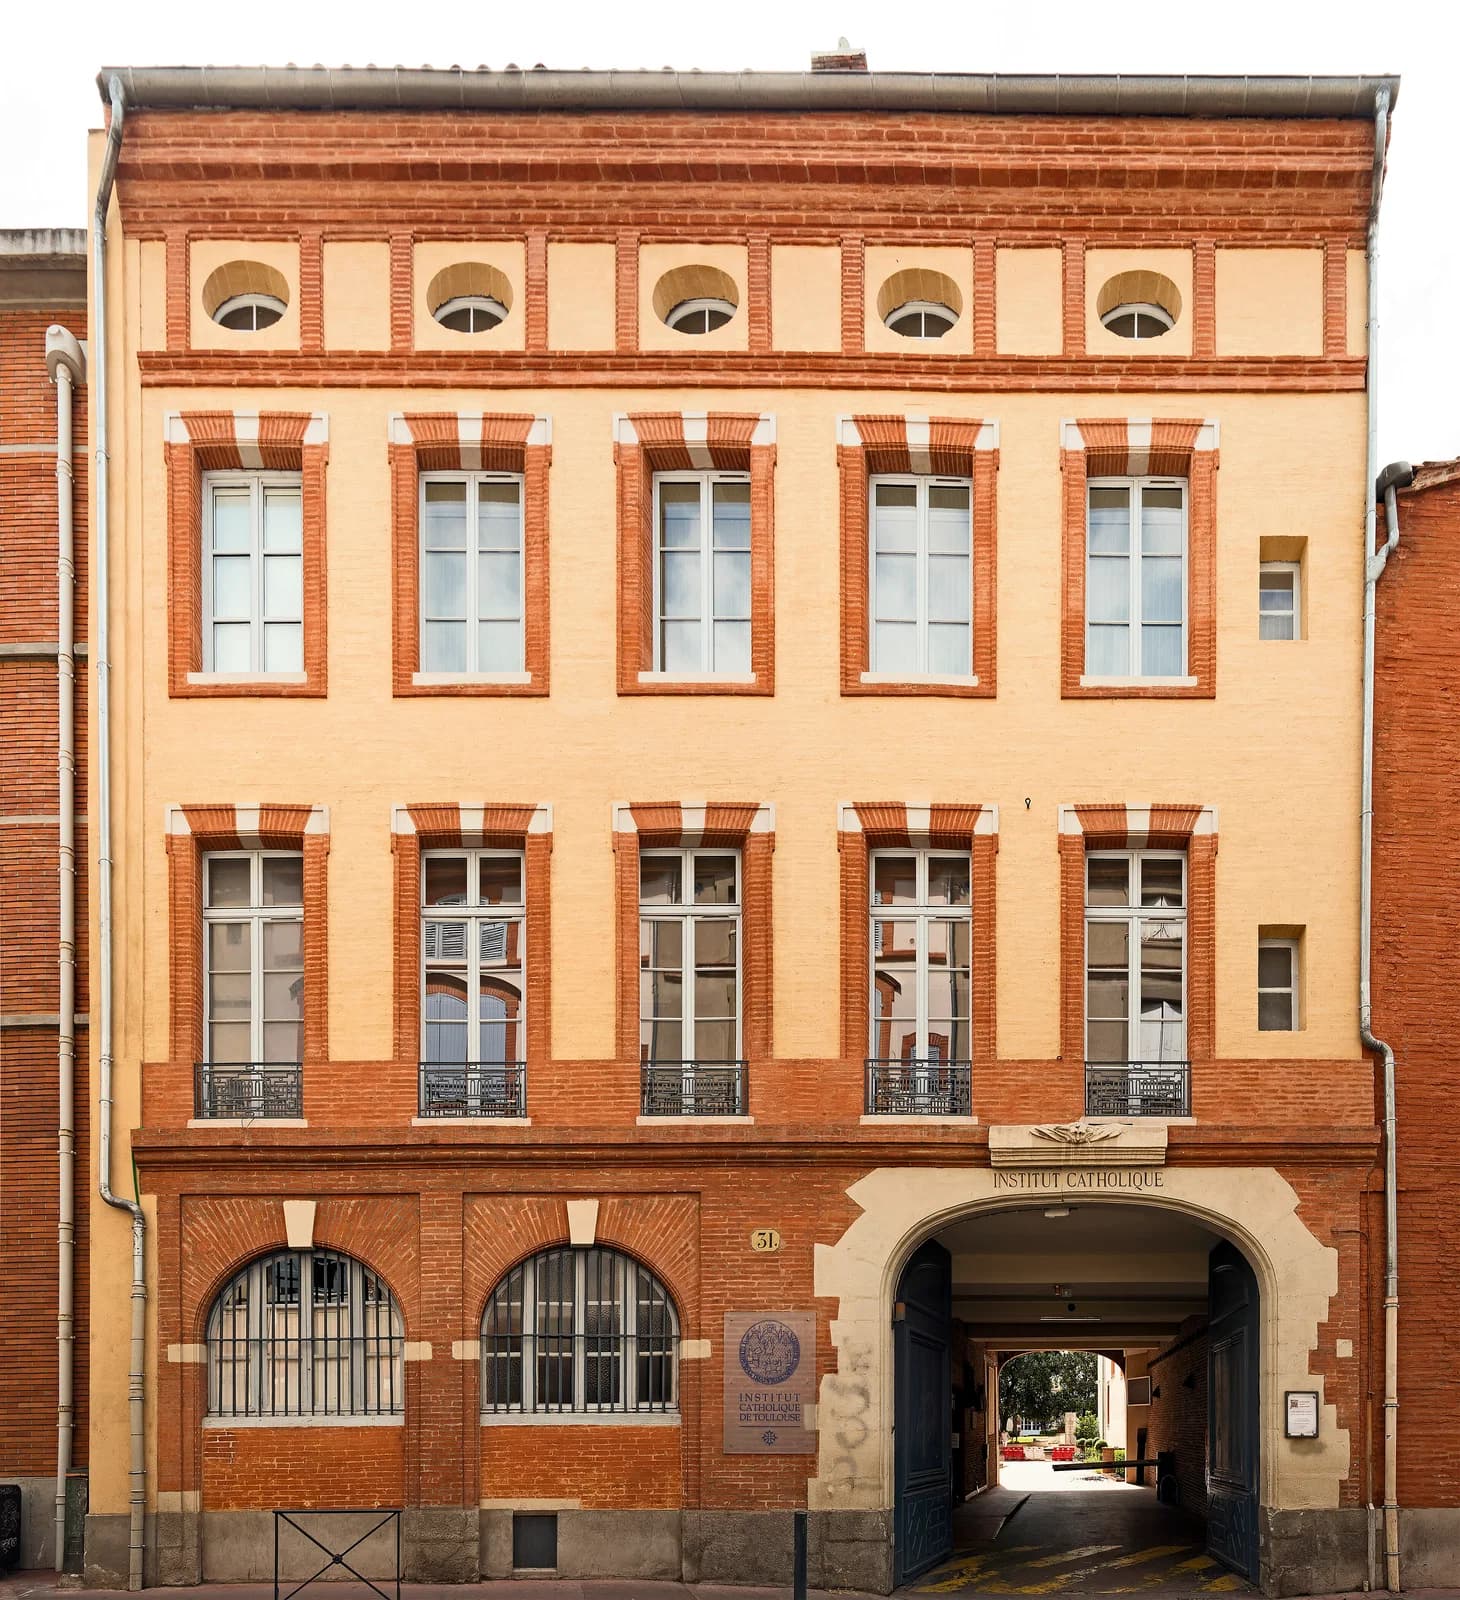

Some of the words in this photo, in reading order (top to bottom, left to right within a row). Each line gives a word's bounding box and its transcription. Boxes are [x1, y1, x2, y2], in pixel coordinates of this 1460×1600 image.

[994, 1172, 1061, 1188] INSTITUT
[1066, 1172, 1164, 1191] CATHOLIQUE
[739, 1393, 801, 1402] INSTITUT
[739, 1403, 801, 1413] CATHOLIQUE
[739, 1413, 752, 1422] DE
[752, 1413, 801, 1422] TOULOUSE
